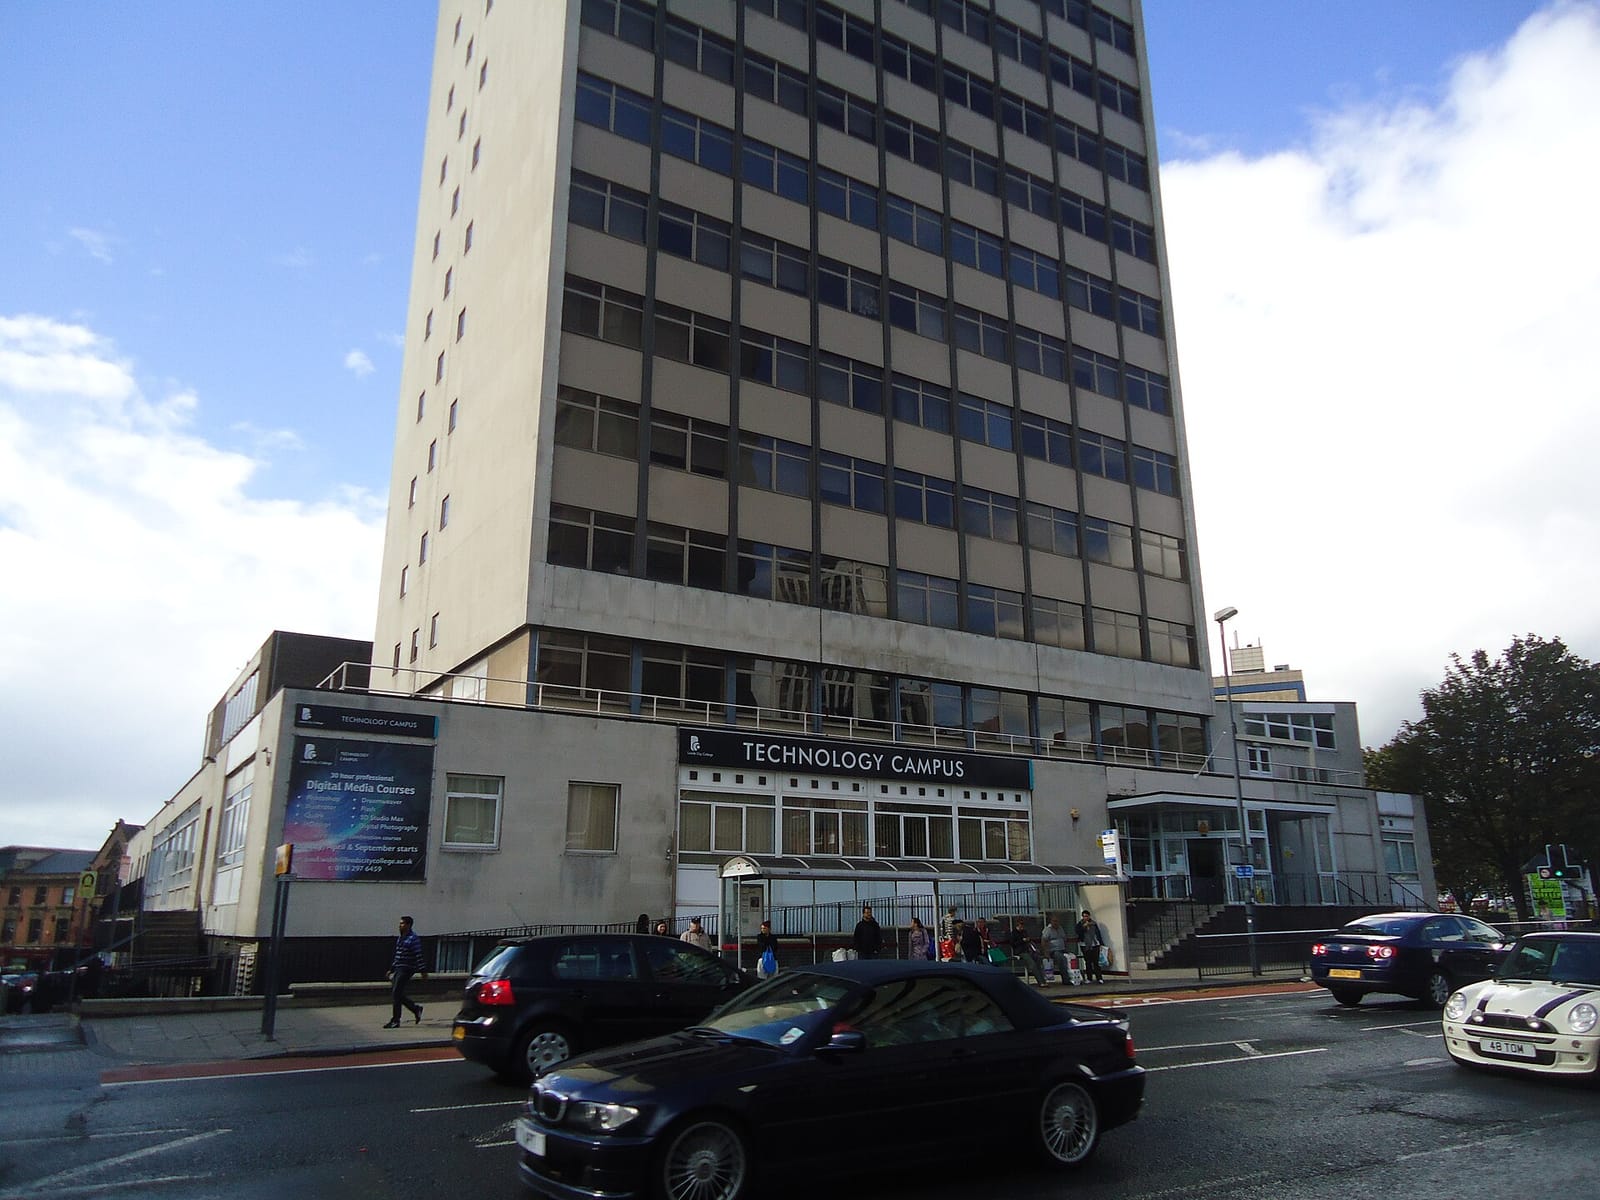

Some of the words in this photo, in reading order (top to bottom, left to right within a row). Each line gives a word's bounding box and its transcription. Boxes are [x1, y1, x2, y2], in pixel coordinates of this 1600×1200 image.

[341, 716, 388, 726] TECHNOLOGY
[390, 720, 418, 728] CAMPUS
[743, 742, 884, 770] TECHNOLOGY
[892, 756, 964, 778] CAMPUS
[356, 774, 394, 782] professional
[306, 780, 341, 793] Digital
[344, 782, 374, 792] Media
[377, 784, 416, 795] Courses
[380, 824, 418, 832] Photography
[354, 844, 395, 853] September
[1490, 1042, 1502, 1051] 48
[1504, 1043, 1524, 1054] TOM
